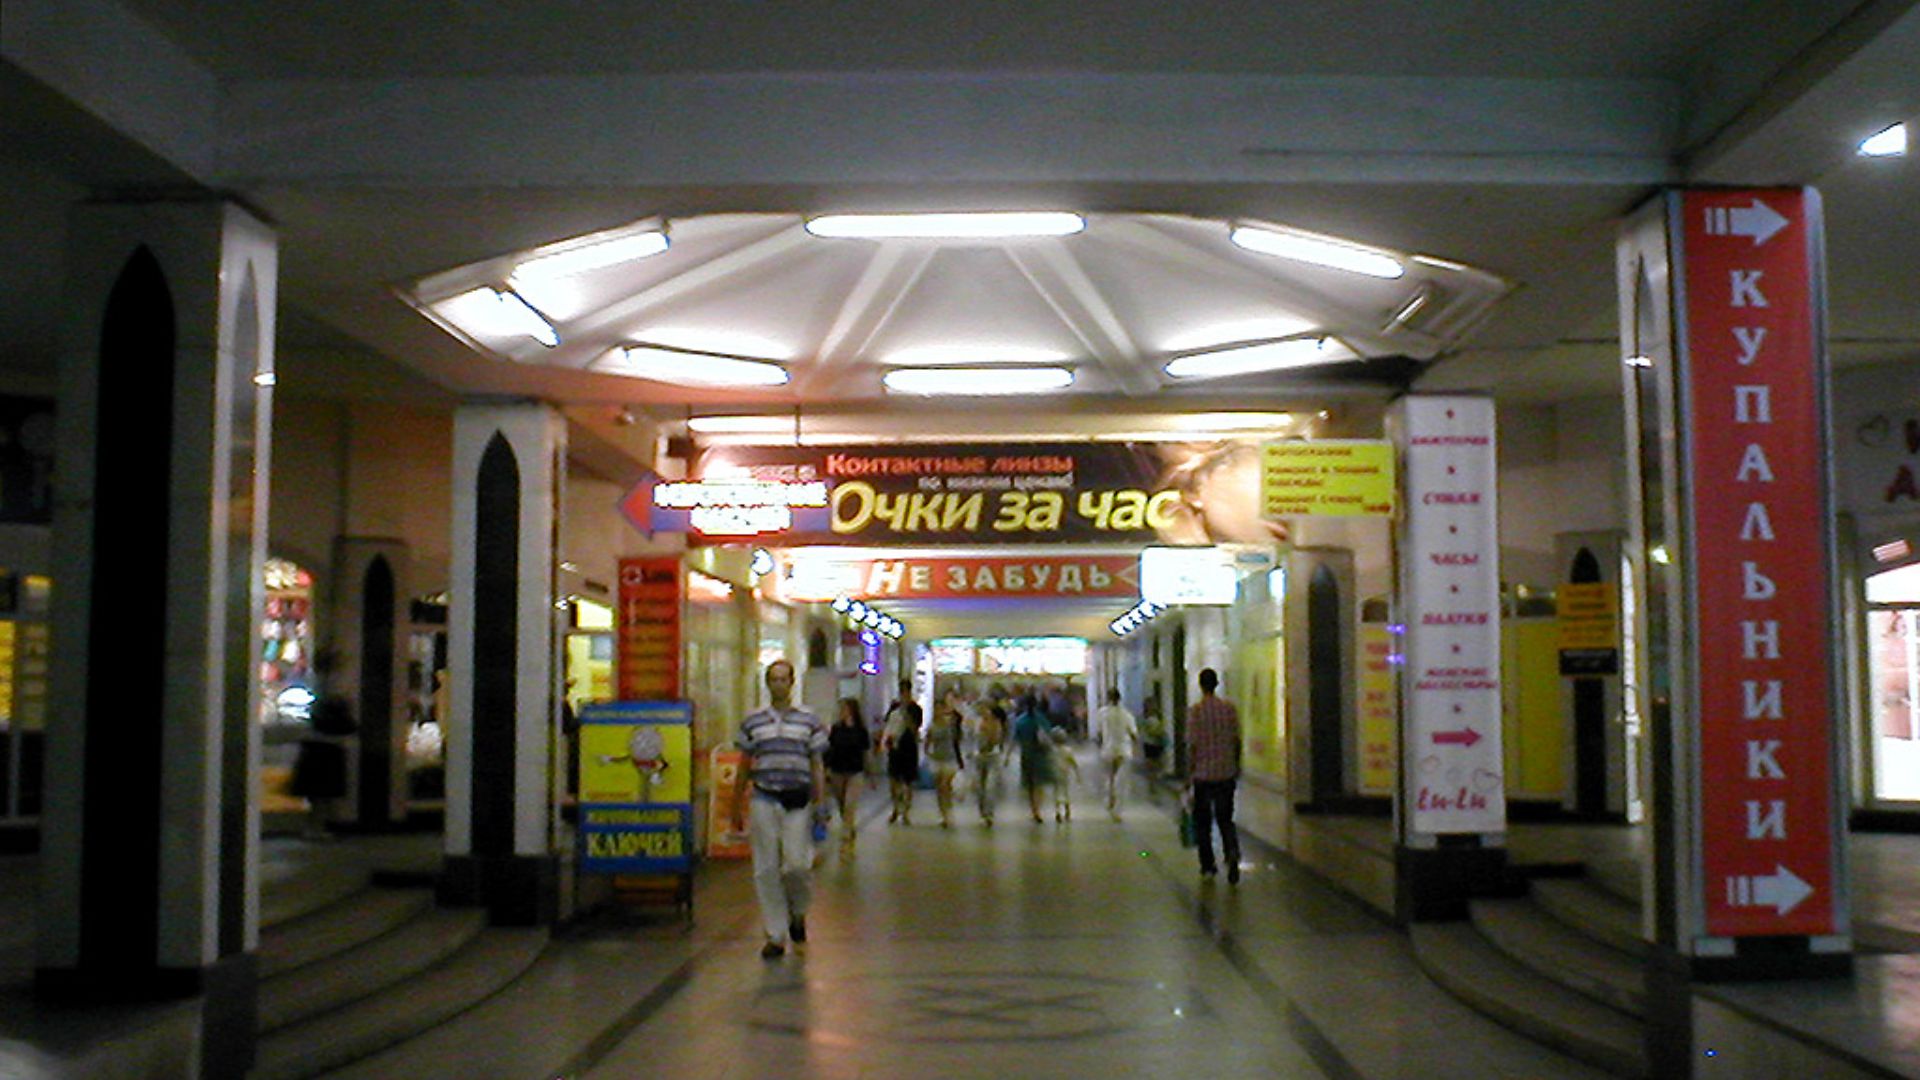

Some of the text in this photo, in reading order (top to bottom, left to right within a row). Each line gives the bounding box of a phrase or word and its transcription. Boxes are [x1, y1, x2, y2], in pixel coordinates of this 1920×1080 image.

[827, 455, 986, 475] Контактные
[991, 456, 1075, 475] линзы
[830, 480, 985, 534] Очки
[993, 490, 1064, 532] за
[1077, 488, 1183, 532] час
[1729, 269, 1787, 840] КУПАЛЬНИКИ
[947, 562, 1113, 593] ЗАБУДЬ
[586, 827, 684, 858] КЛЮЧЕЙ
